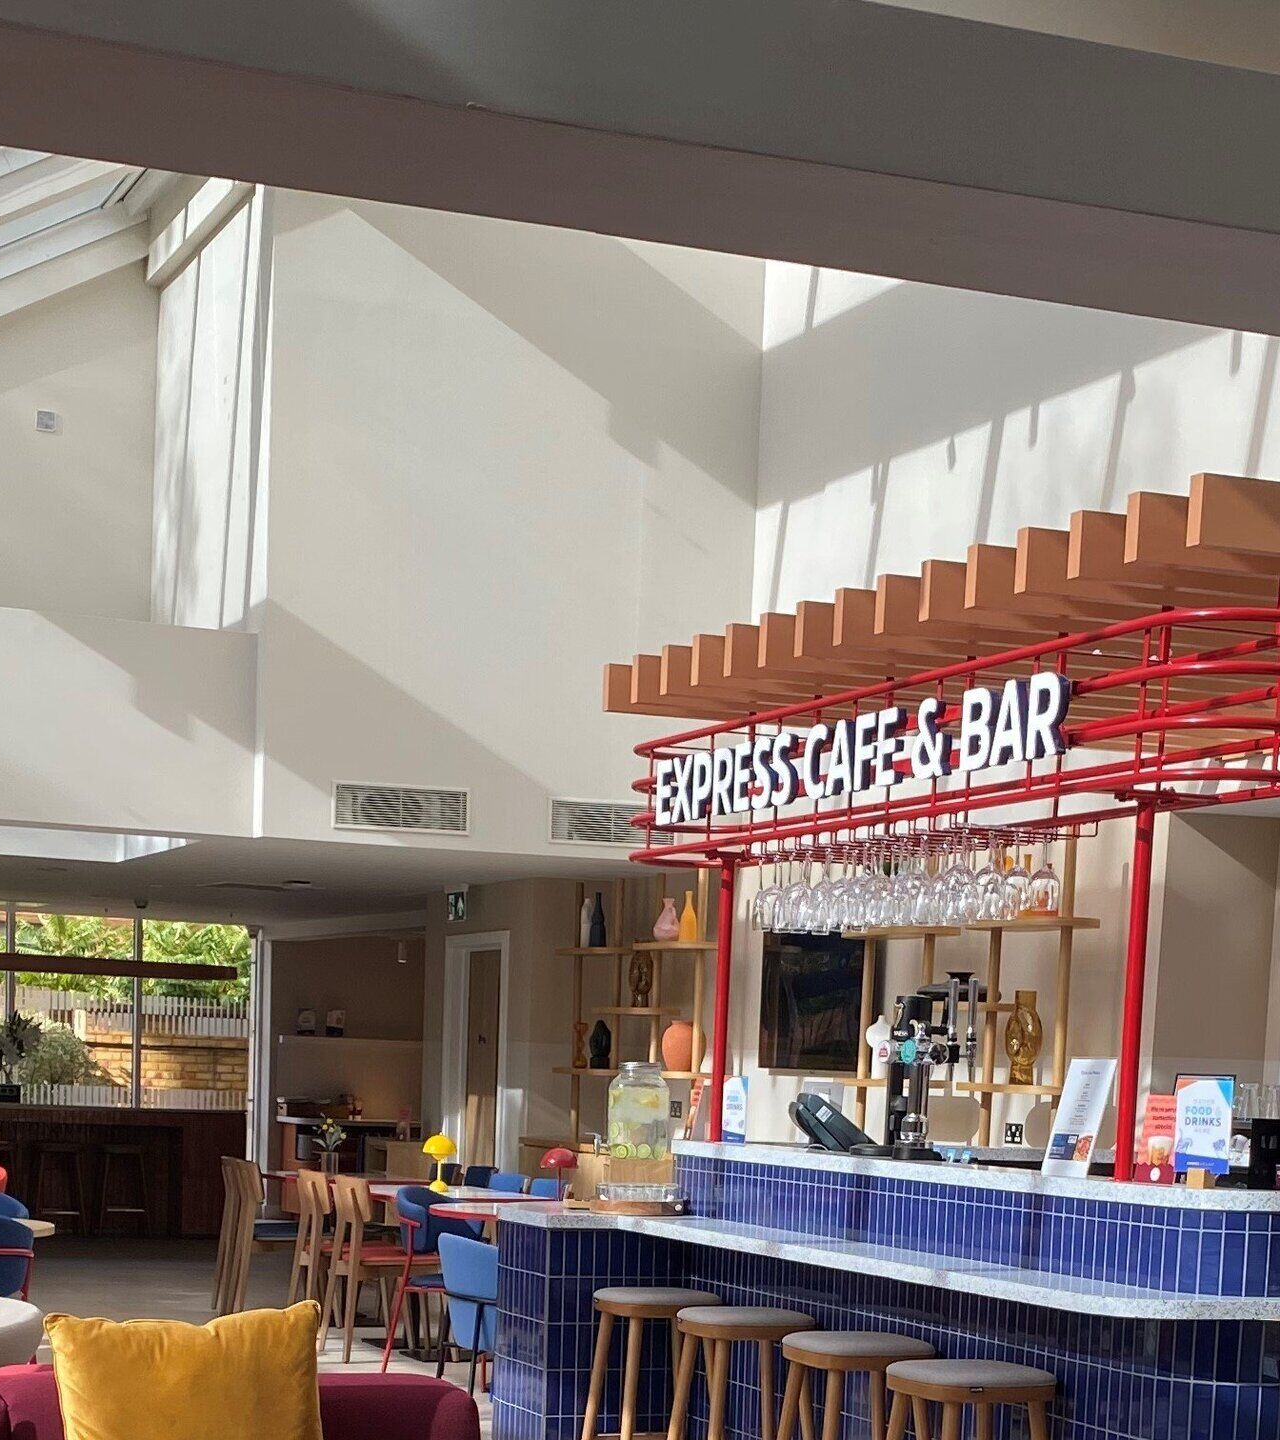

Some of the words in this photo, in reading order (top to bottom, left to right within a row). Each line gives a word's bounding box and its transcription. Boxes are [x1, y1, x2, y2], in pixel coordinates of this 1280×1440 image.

[655, 732, 798, 826] EXPRESS
[803, 706, 905, 800] CAFE
[912, 697, 949, 780] &
[958, 671, 1067, 772] BAR
[1185, 1106, 1213, 1116] FOOD
[1184, 1116, 1222, 1127] DRINKS
